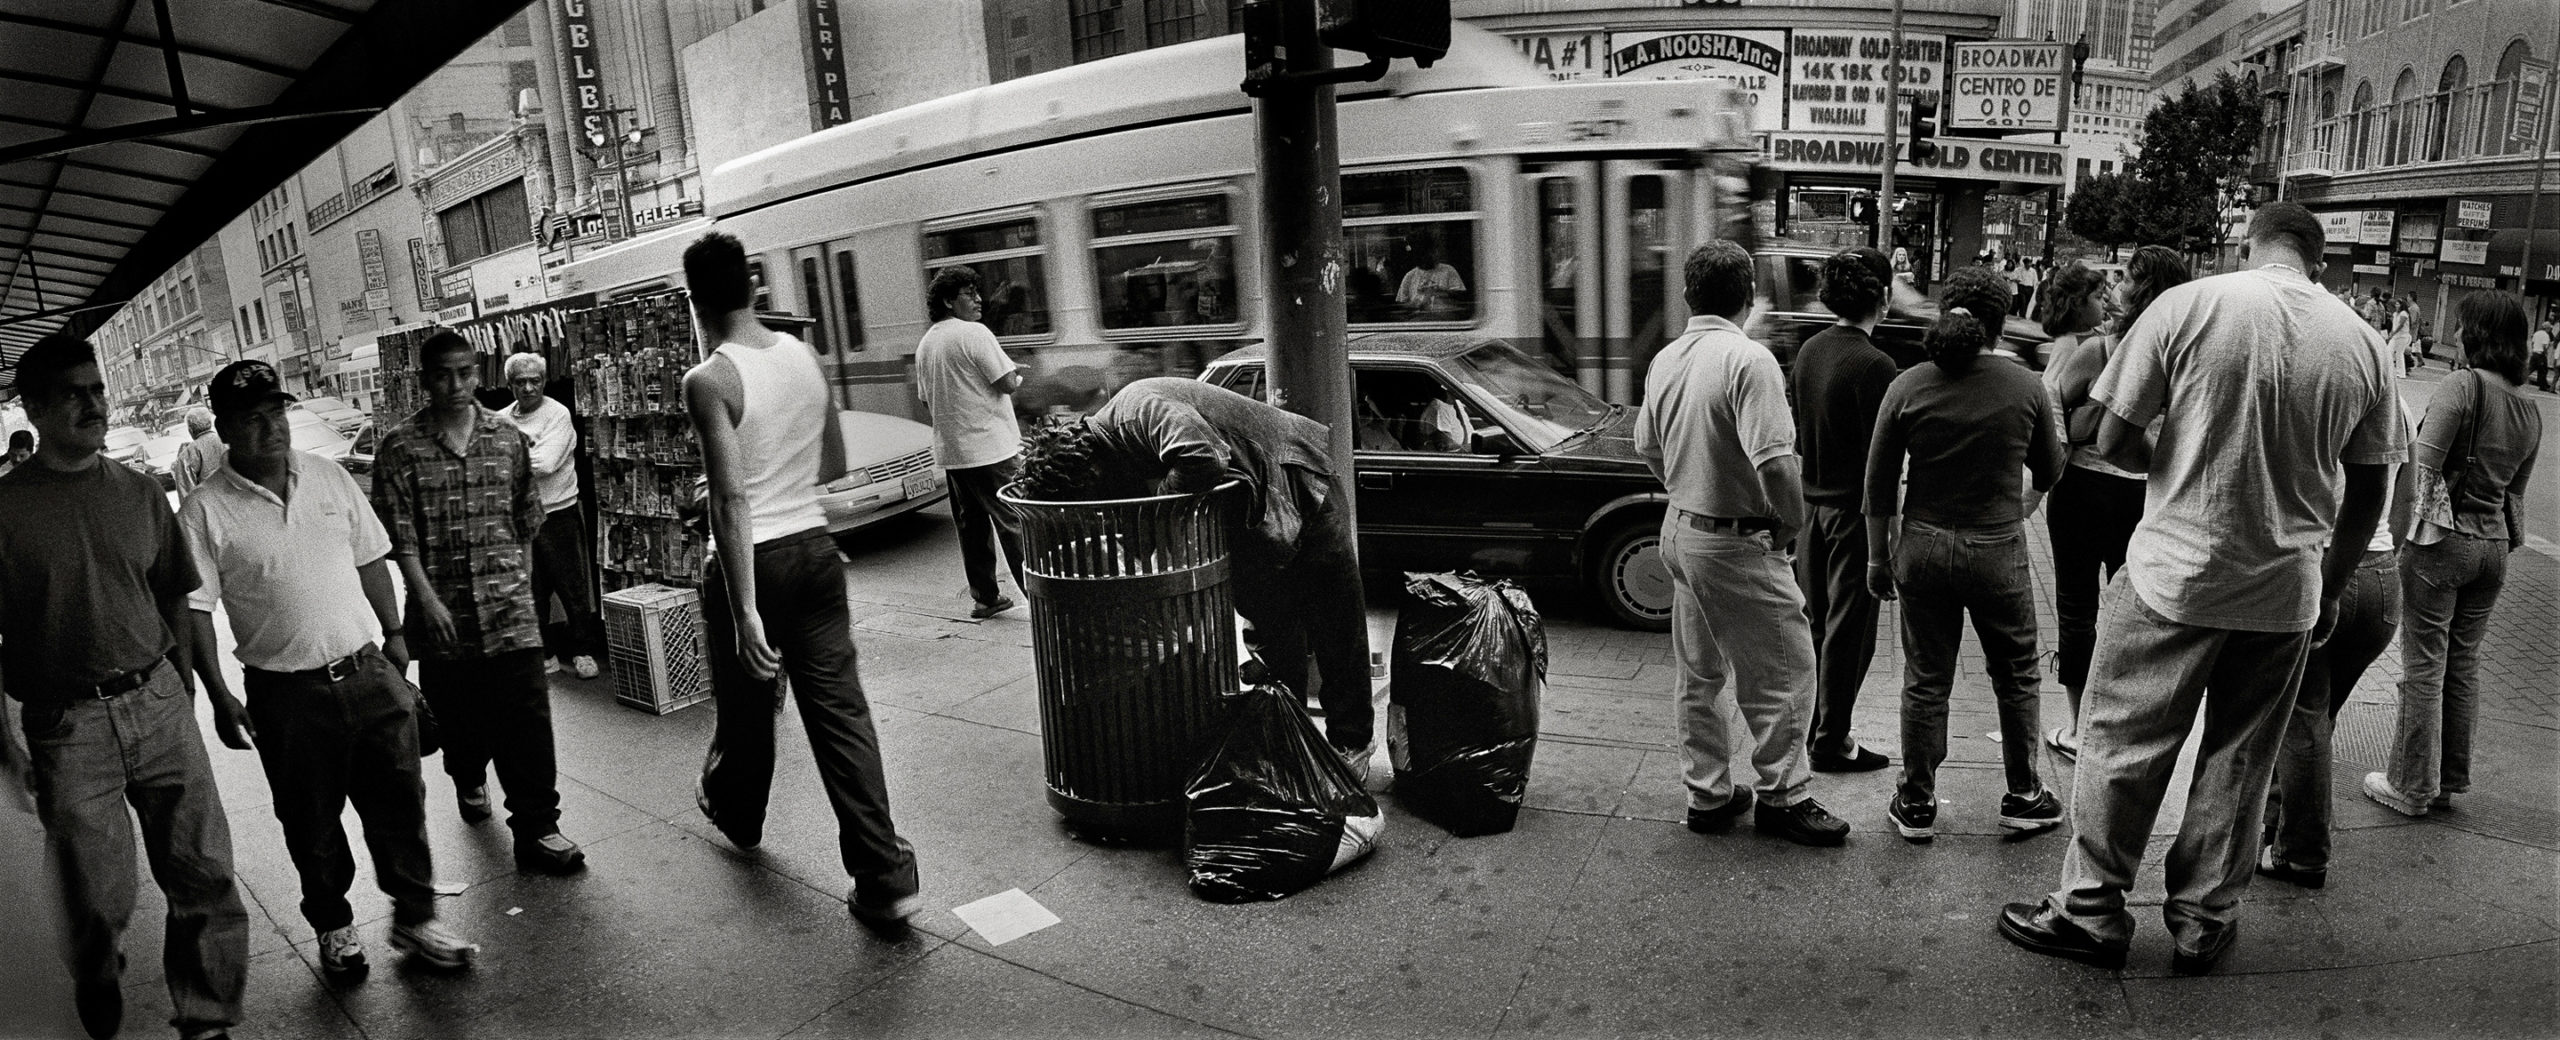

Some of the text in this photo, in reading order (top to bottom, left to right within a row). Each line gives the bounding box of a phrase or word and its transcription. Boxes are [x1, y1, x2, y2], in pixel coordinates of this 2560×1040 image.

[1794, 35, 1853, 58] BROADWAY
[817, 0, 843, 126] ELRY PLA
[1961, 48, 2058, 68] BROADWAY
[565, 0, 604, 139] GELES
[1802, 62, 1835, 80] 14K
[1840, 63, 1873, 81] 18K
[1960, 77, 2057, 96] CENTRO DE
[1810, 107, 1866, 125] WHOLESALE
[1986, 118, 2024, 126] 601
[1774, 138, 1904, 164] BROADWAY
[1979, 147, 2063, 177] CENTER
[633, 203, 681, 226] GELES
[2461, 201, 2490, 211] WATCHES
[2462, 210, 2486, 219] GIFTS
[412, 241, 429, 298] DIAMONDS
